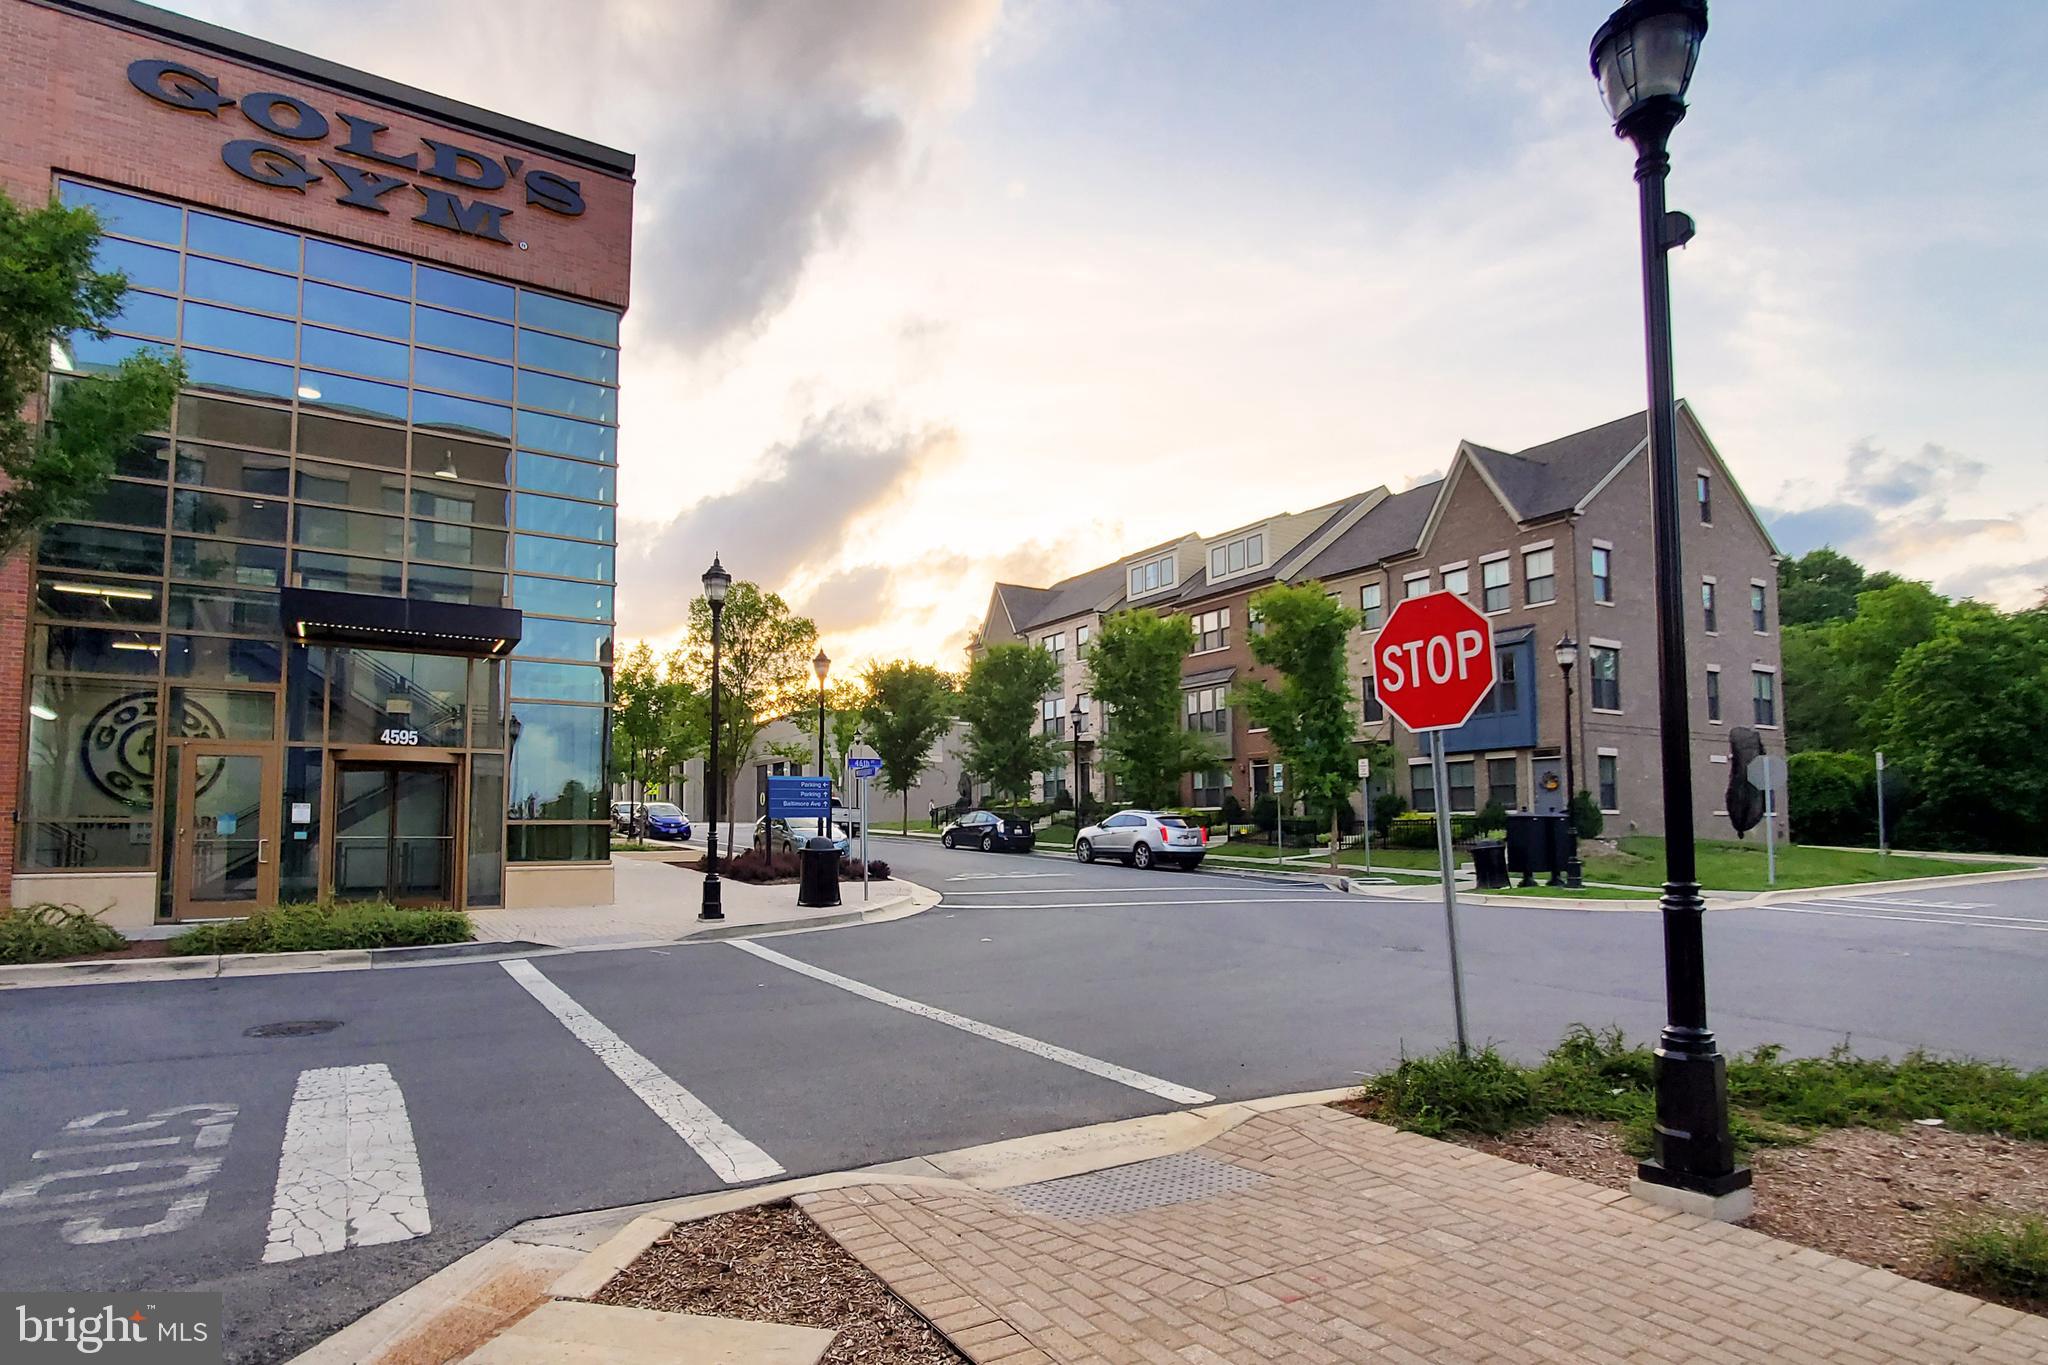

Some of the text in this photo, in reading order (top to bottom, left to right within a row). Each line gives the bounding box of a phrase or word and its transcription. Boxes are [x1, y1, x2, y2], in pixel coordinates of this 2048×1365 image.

[127, 59, 586, 216] GOLD'S
[221, 139, 514, 246] GYM
[1382, 629, 1483, 692] STOP
[380, 728, 419, 746] 4595
